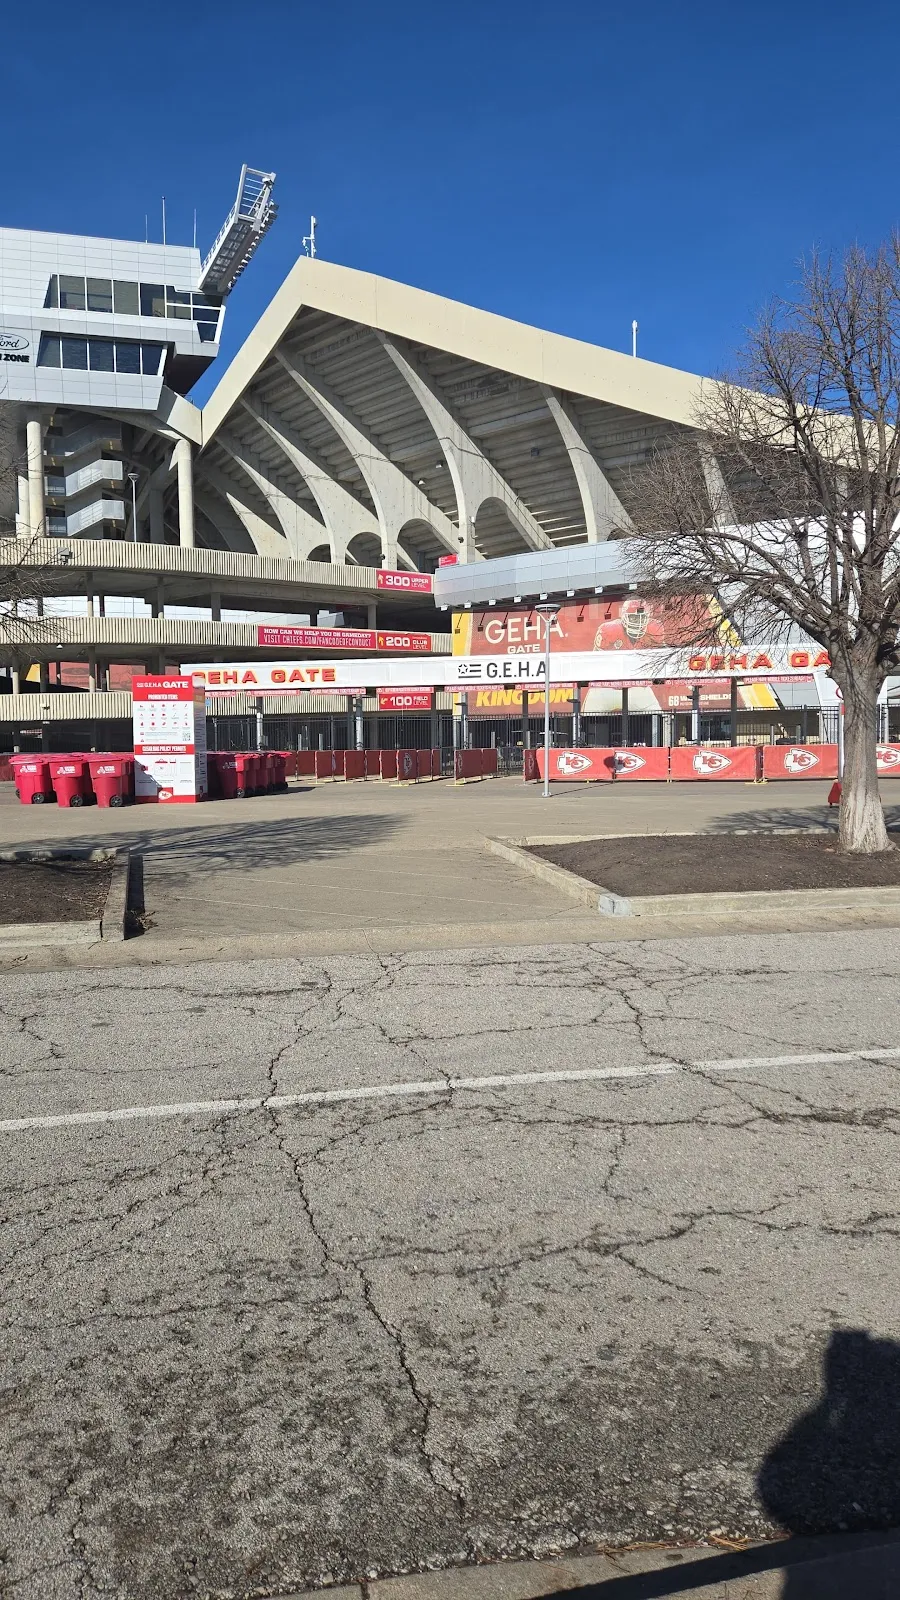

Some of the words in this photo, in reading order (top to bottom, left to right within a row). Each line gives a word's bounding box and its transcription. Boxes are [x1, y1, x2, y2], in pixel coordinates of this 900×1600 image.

[4, 354, 30, 362] ZONE
[386, 575, 410, 586] 300
[264, 634, 280, 643] VISIT
[283, 635, 371, 646] CHIEFS.COM/FANCODEOFCONDUCT
[386, 636, 410, 646] 200
[507, 644, 540, 654] GATE
[688, 654, 773, 670] GEHA
[486, 661, 546, 678] G.E.H.A
[270, 668, 336, 683] GATE
[390, 696, 412, 706] 100
[476, 688, 573, 707] KINGDOM
[668, 696, 679, 706] 68
